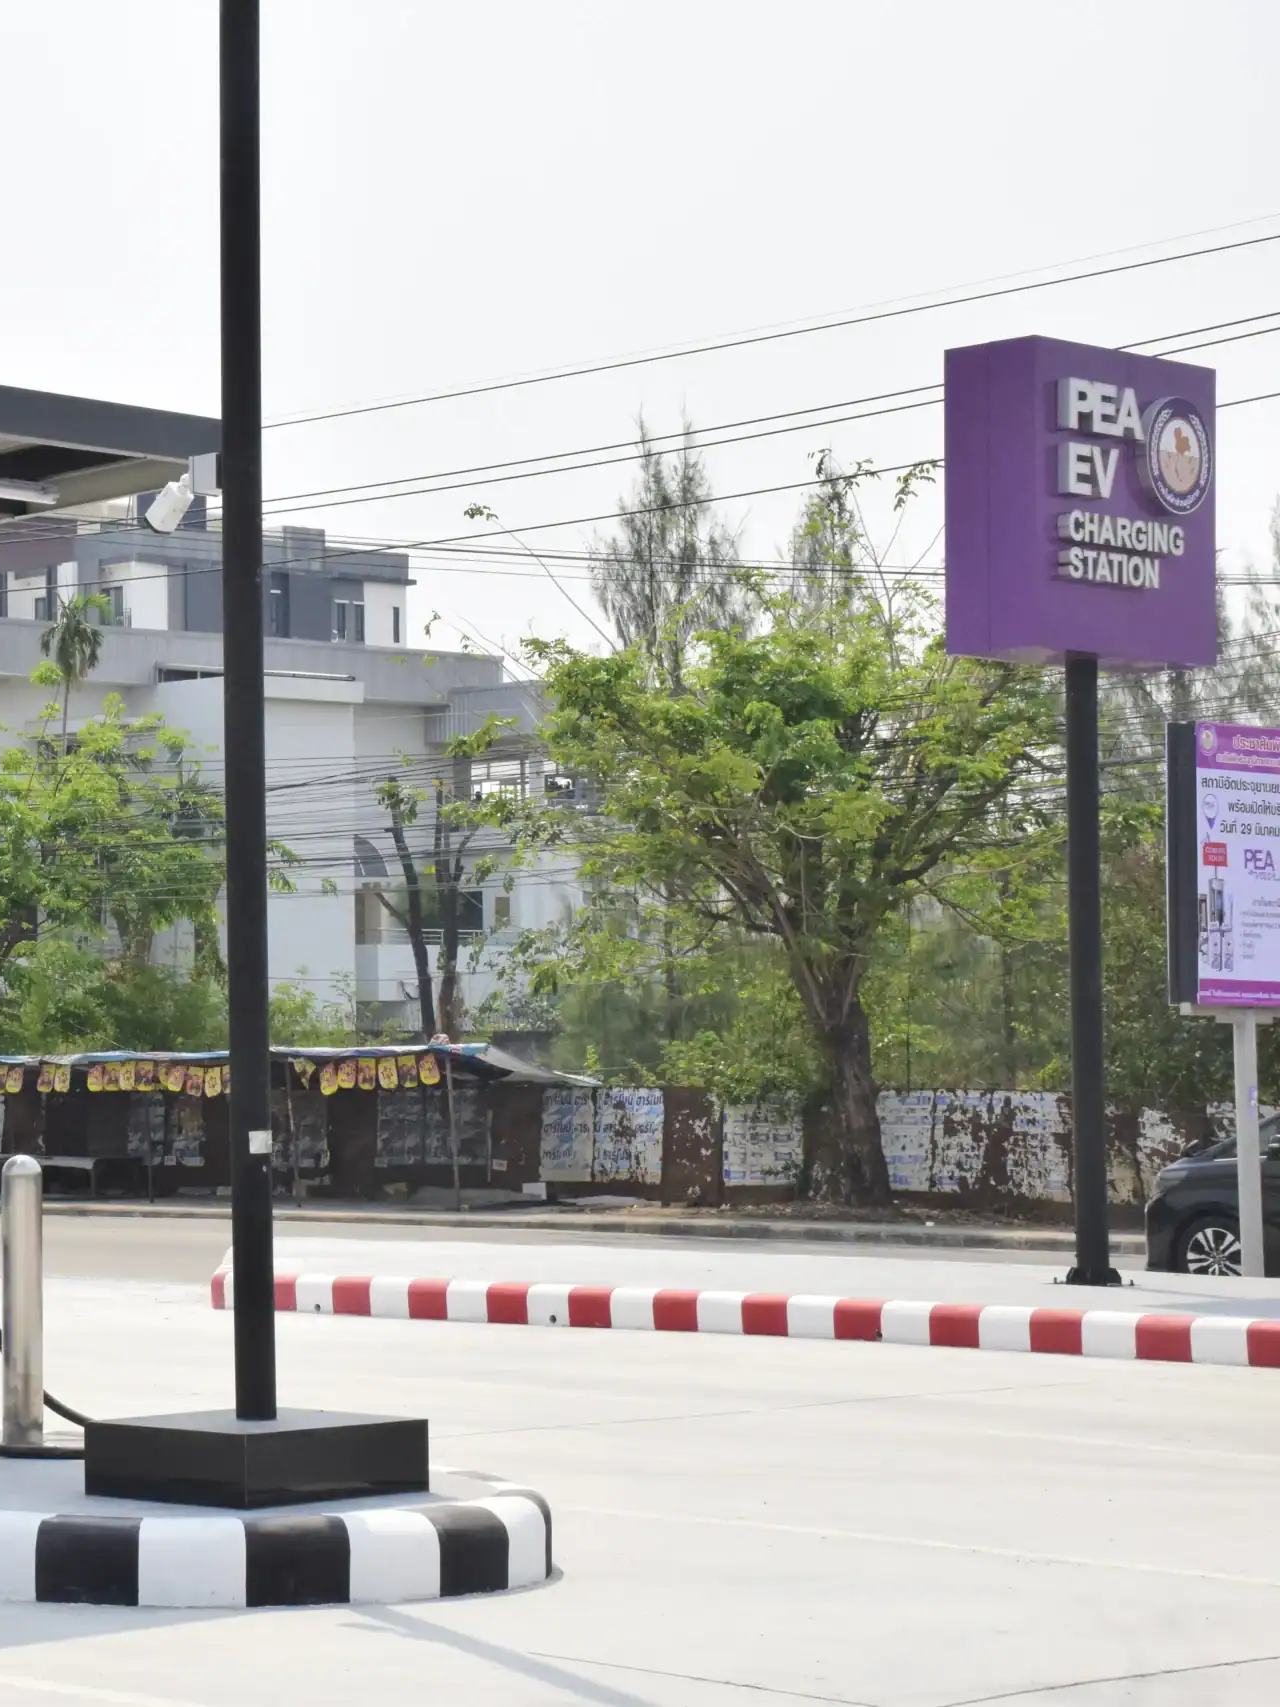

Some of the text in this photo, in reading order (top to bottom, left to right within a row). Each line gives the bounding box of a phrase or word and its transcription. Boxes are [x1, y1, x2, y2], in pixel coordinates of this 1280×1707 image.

[1068, 377, 1144, 441] PEA
[1068, 441, 1119, 499] EV
[1068, 510, 1185, 556] CHARGING
[1068, 546, 1159, 589] STATION
[1240, 823, 1252, 835] 29
[1244, 849, 1275, 871] PEA
